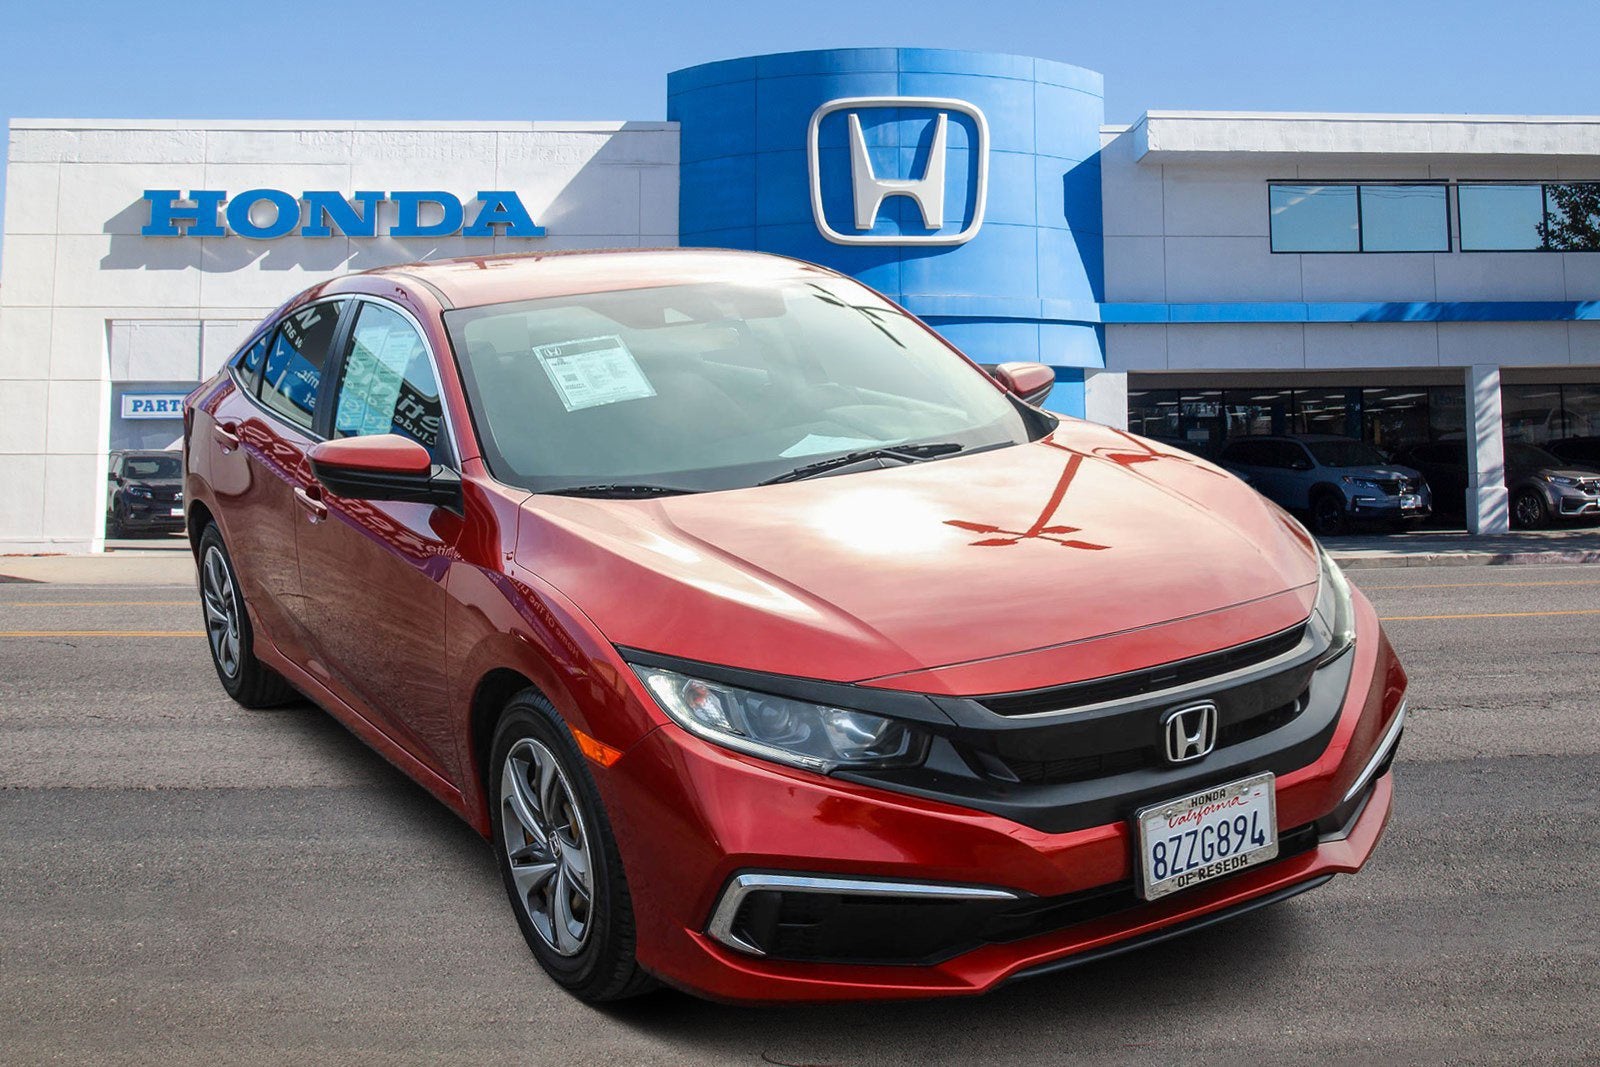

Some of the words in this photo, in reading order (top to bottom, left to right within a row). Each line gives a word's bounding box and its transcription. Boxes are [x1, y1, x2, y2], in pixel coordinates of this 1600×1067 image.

[141, 188, 547, 239] HONDA
[132, 399, 184, 412] PART
[1168, 796, 1249, 828] California
[1190, 788, 1226, 807] HONDA
[1152, 810, 1266, 880] 8ZZG894
[1177, 874, 1197, 888] OF
[1198, 854, 1249, 881] RESEDA
